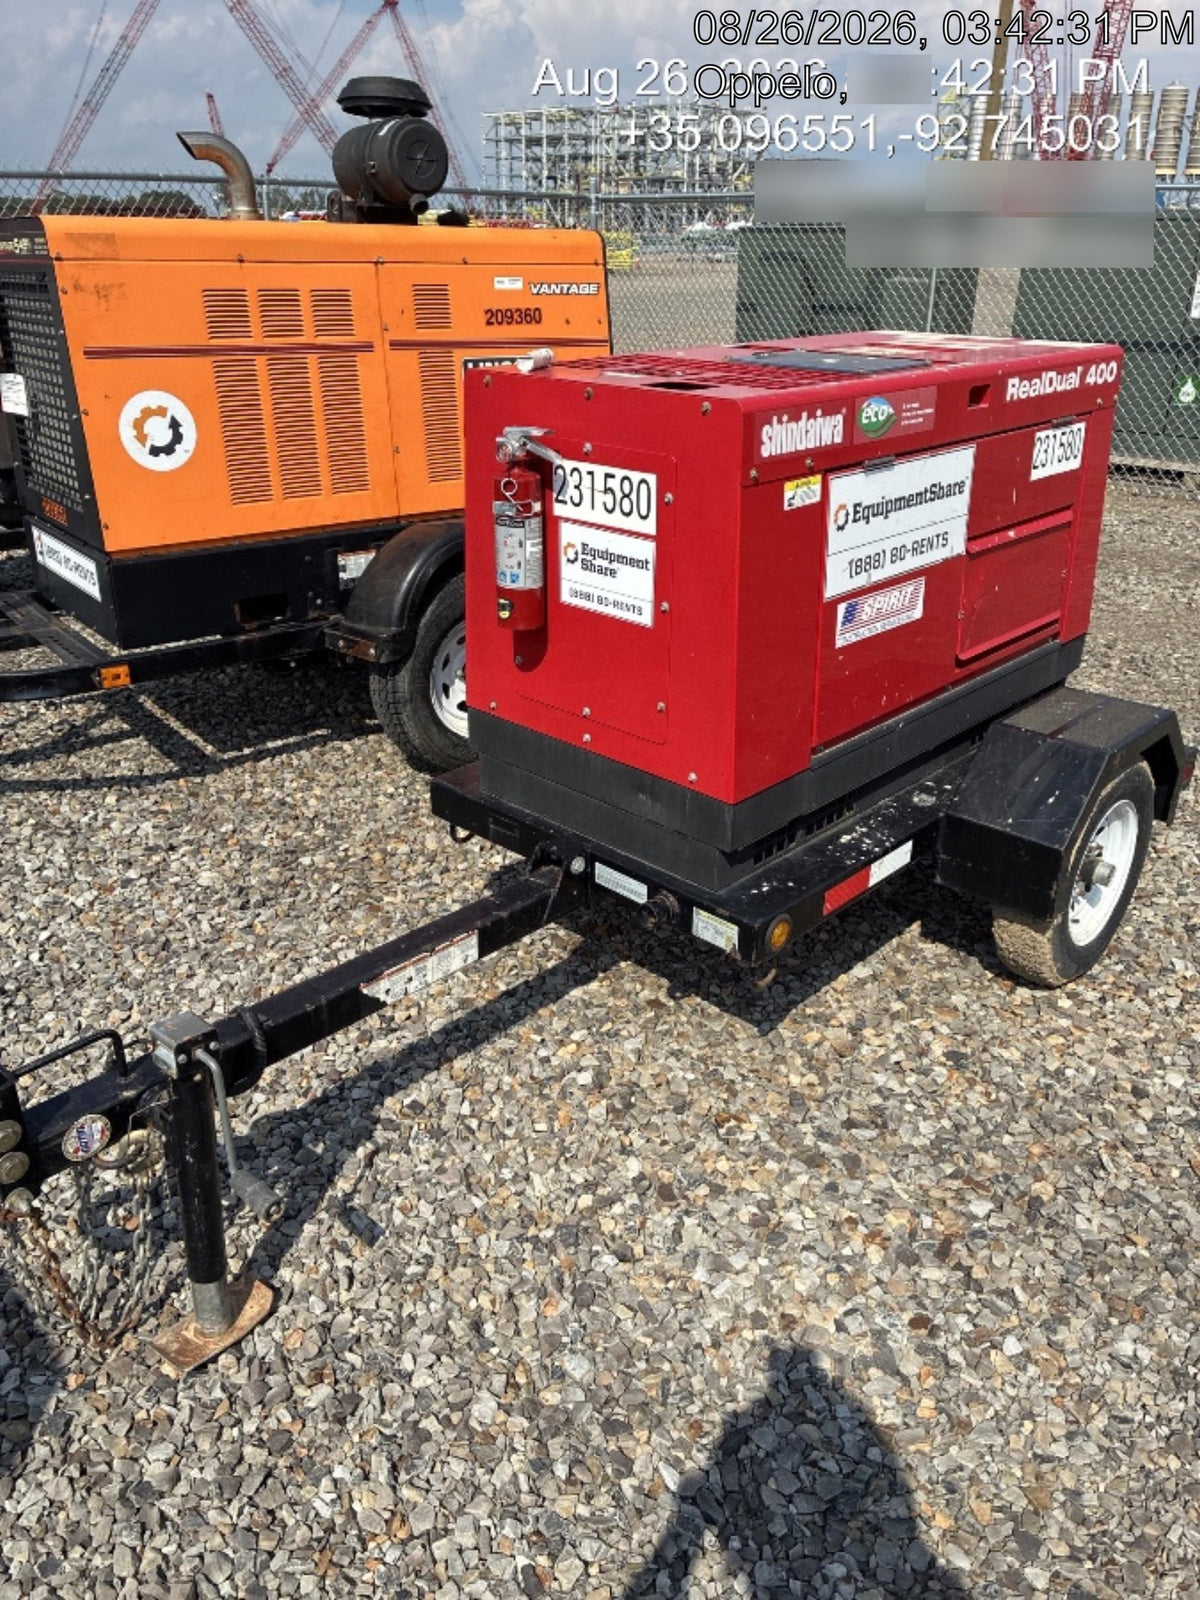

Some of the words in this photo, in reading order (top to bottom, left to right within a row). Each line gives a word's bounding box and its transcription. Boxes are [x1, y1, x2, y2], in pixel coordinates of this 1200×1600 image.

[529, 283, 600, 295] VANTAGE
[484, 307, 543, 326] 209360
[1006, 366, 1081, 401] RealDual
[1085, 360, 1118, 386] 400
[861, 405, 889, 424] eco
[761, 408, 844, 458] shindaiwa
[1032, 427, 1082, 471] 231580
[554, 464, 651, 520] 231580
[851, 481, 967, 525] EquipmentShare
[580, 541, 650, 572] Equipment
[580, 557, 619, 579] Share
[849, 549, 886, 579] (888)
[861, 585, 914, 620] SPIRIT
